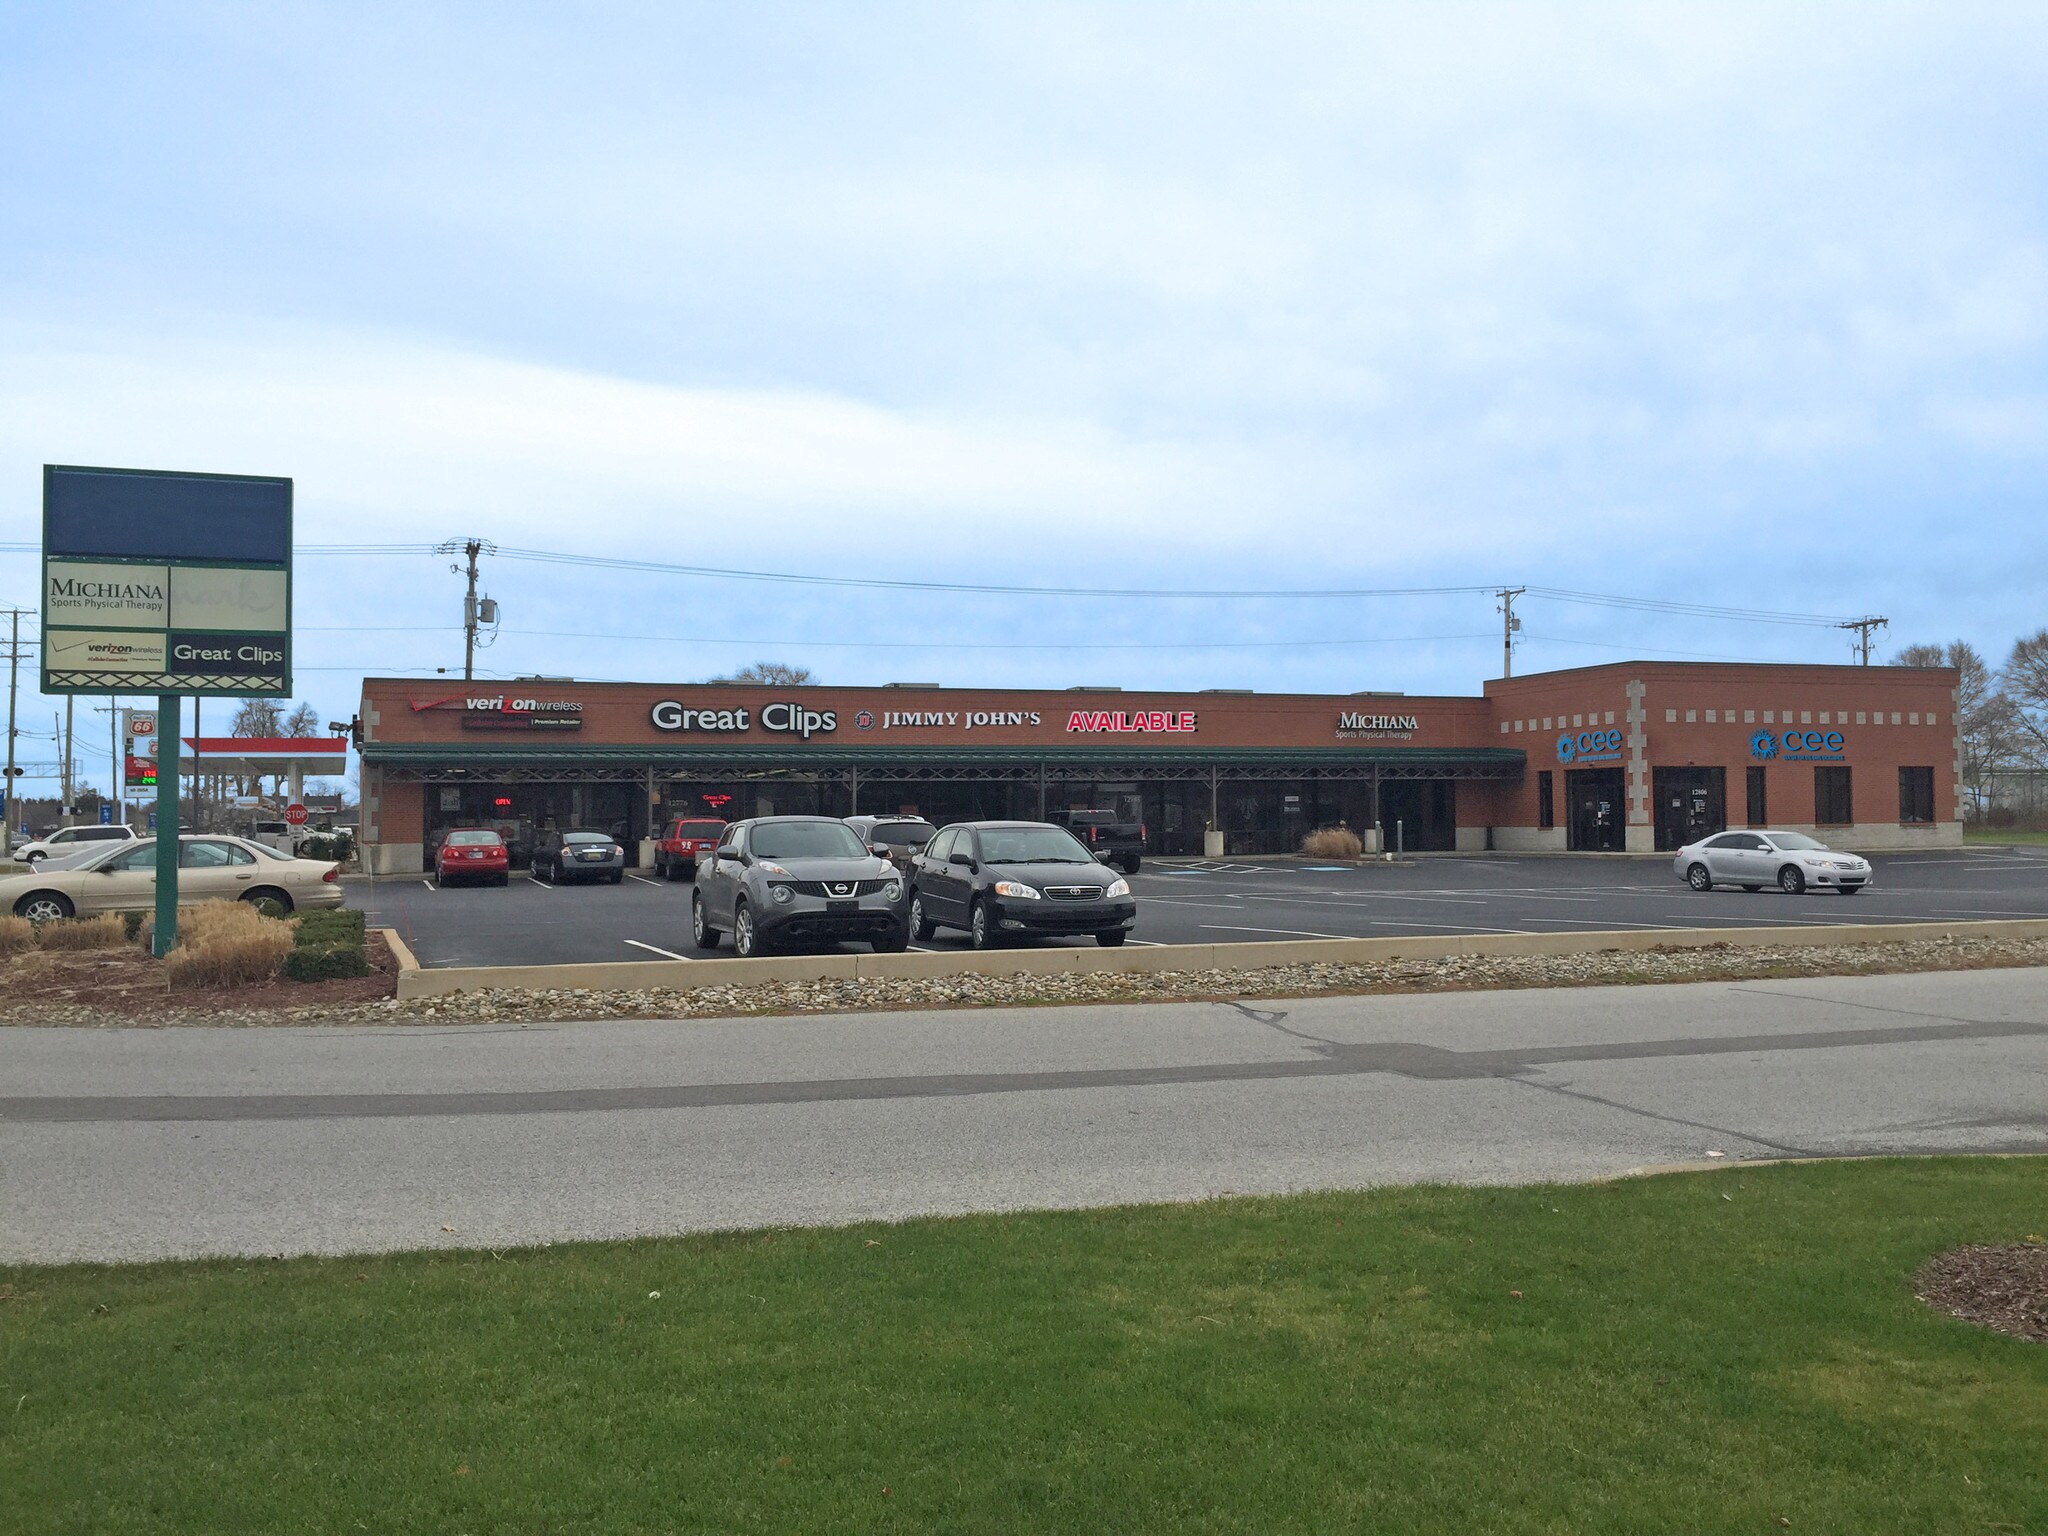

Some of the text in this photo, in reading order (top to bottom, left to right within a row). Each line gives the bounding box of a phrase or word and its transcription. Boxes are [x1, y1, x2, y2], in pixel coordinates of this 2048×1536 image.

[50, 577, 164, 600] MICHIANA
[51, 597, 163, 612] Sports Physical Therapy
[173, 644, 283, 666] Great Clips
[133, 721, 151, 732] 66
[652, 701, 750, 730] Great
[761, 703, 837, 738] Clips
[882, 711, 959, 729] JIMMY
[964, 711, 1041, 730] JOHN'S
[1066, 711, 1196, 732] AVAILABLE
[1339, 711, 1420, 729] MICHIANA
[1335, 730, 1413, 741] Sports Physical Therapy
[1577, 729, 1623, 753] cee
[1781, 730, 1845, 751] cee
[286, 810, 307, 819] STOP
